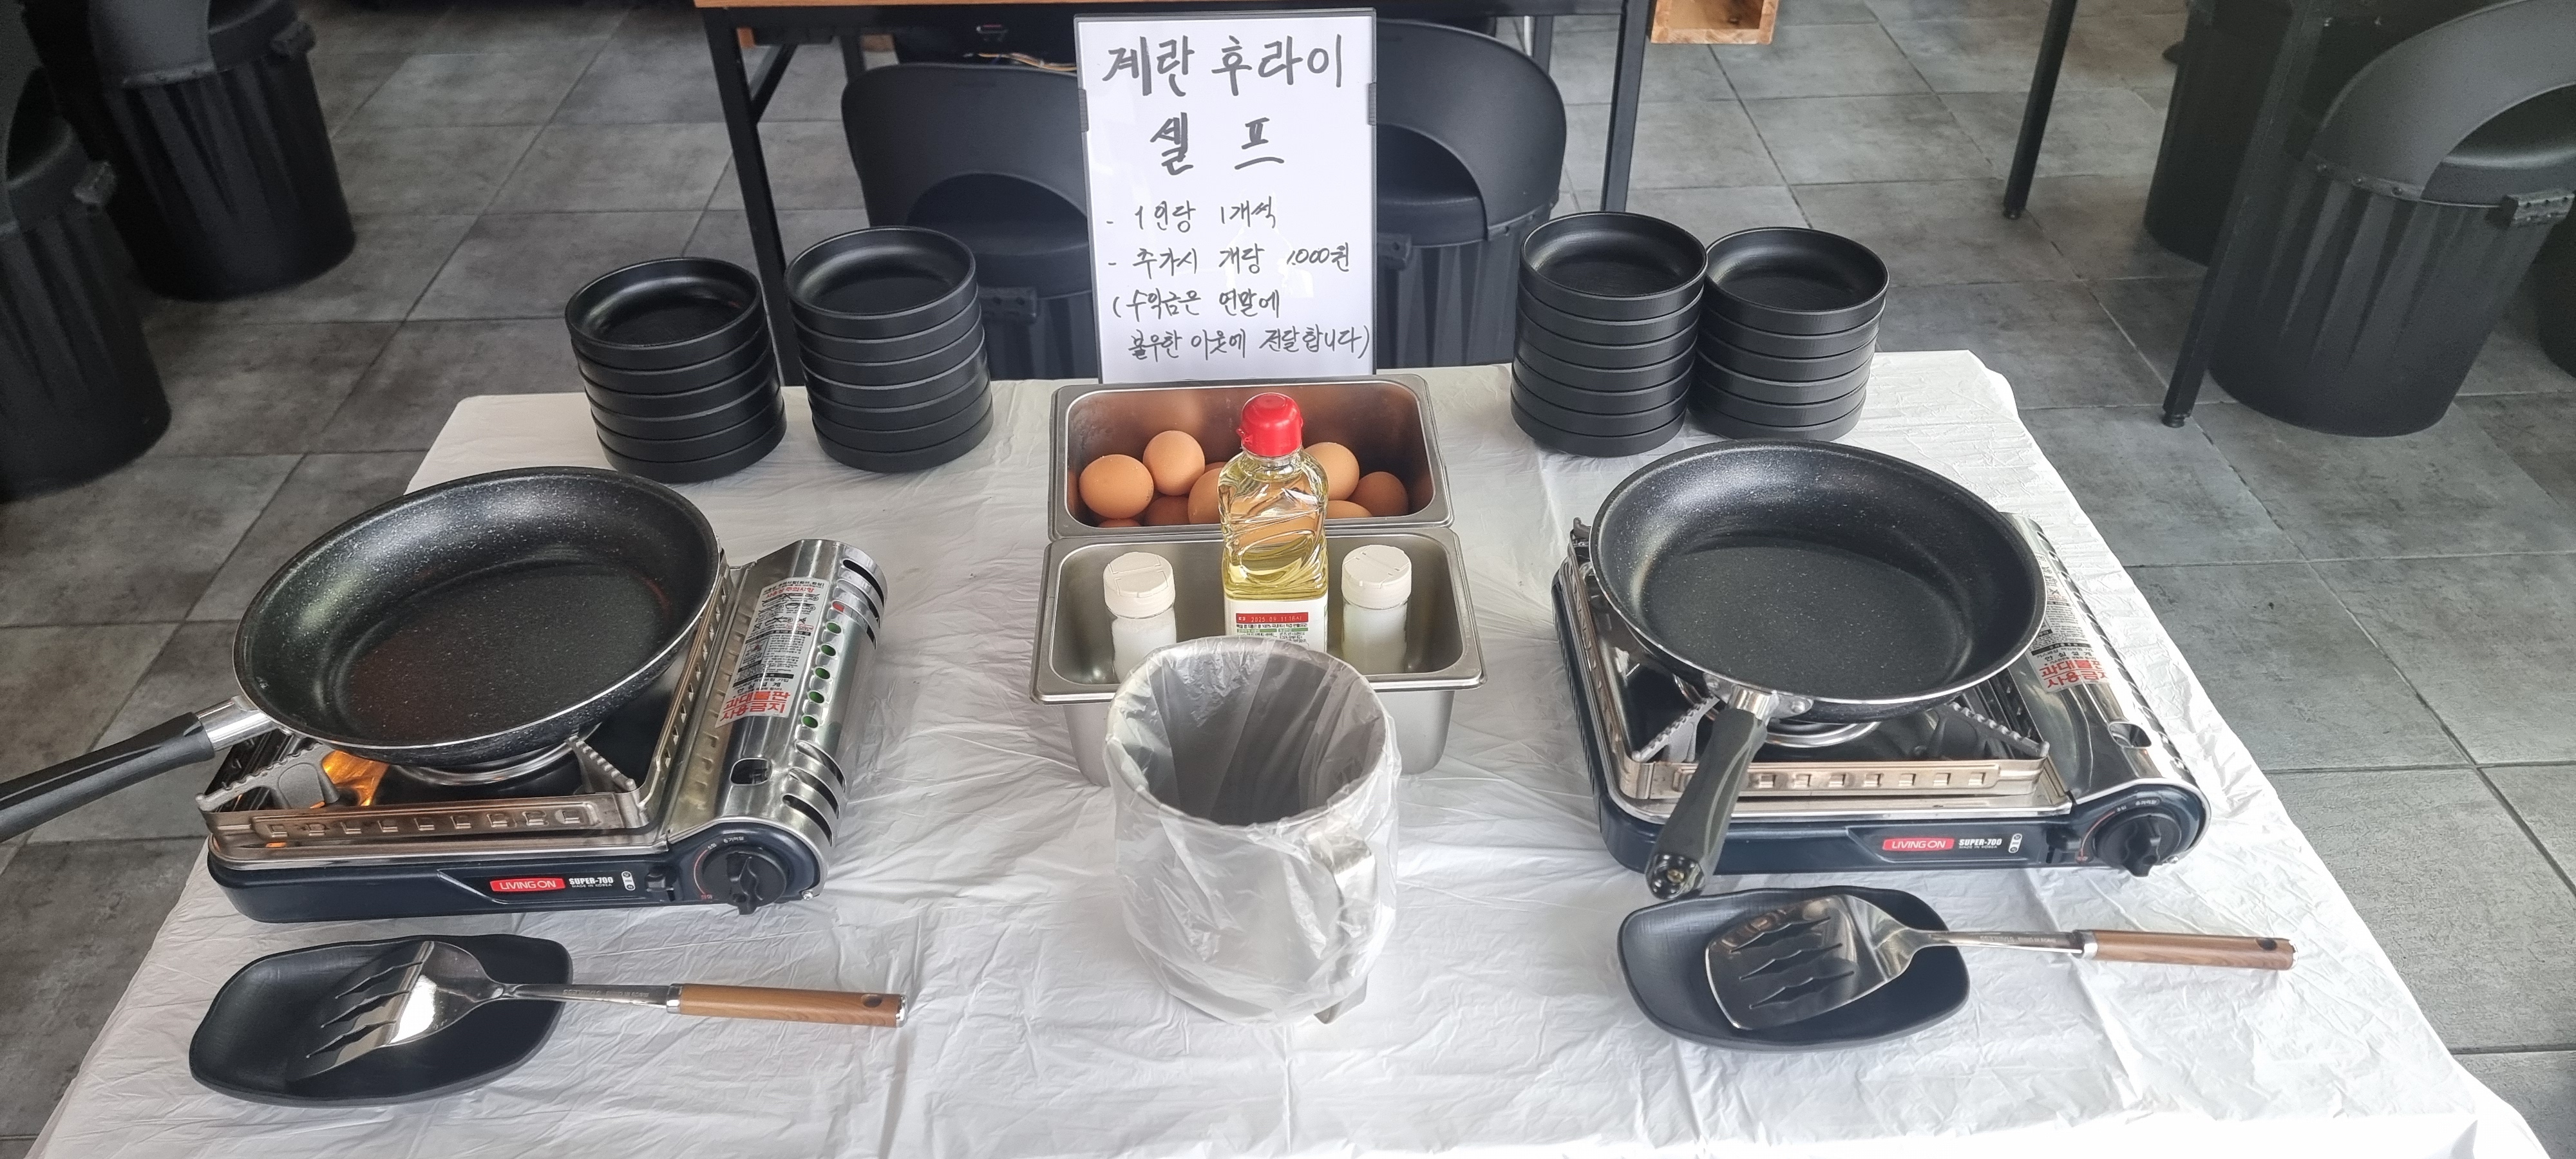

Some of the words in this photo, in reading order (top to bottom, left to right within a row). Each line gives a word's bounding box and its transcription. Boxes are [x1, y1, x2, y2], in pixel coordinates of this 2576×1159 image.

[1102, 35, 1195, 97] 계란
[1211, 34, 1342, 97] 후라이
[1132, 247, 1197, 280] 추가시
[1218, 243, 1265, 274] 개당
[1218, 288, 1280, 319] 연말에
[1190, 328, 1246, 361] 이웃에
[720, 702, 786, 721] 사용금지
[1891, 840, 1927, 849] LIVING
[1927, 840, 1946, 849] ON
[499, 880, 537, 890] LIVING
[538, 880, 556, 889] ON
[568, 876, 614, 885] SUPER-700
